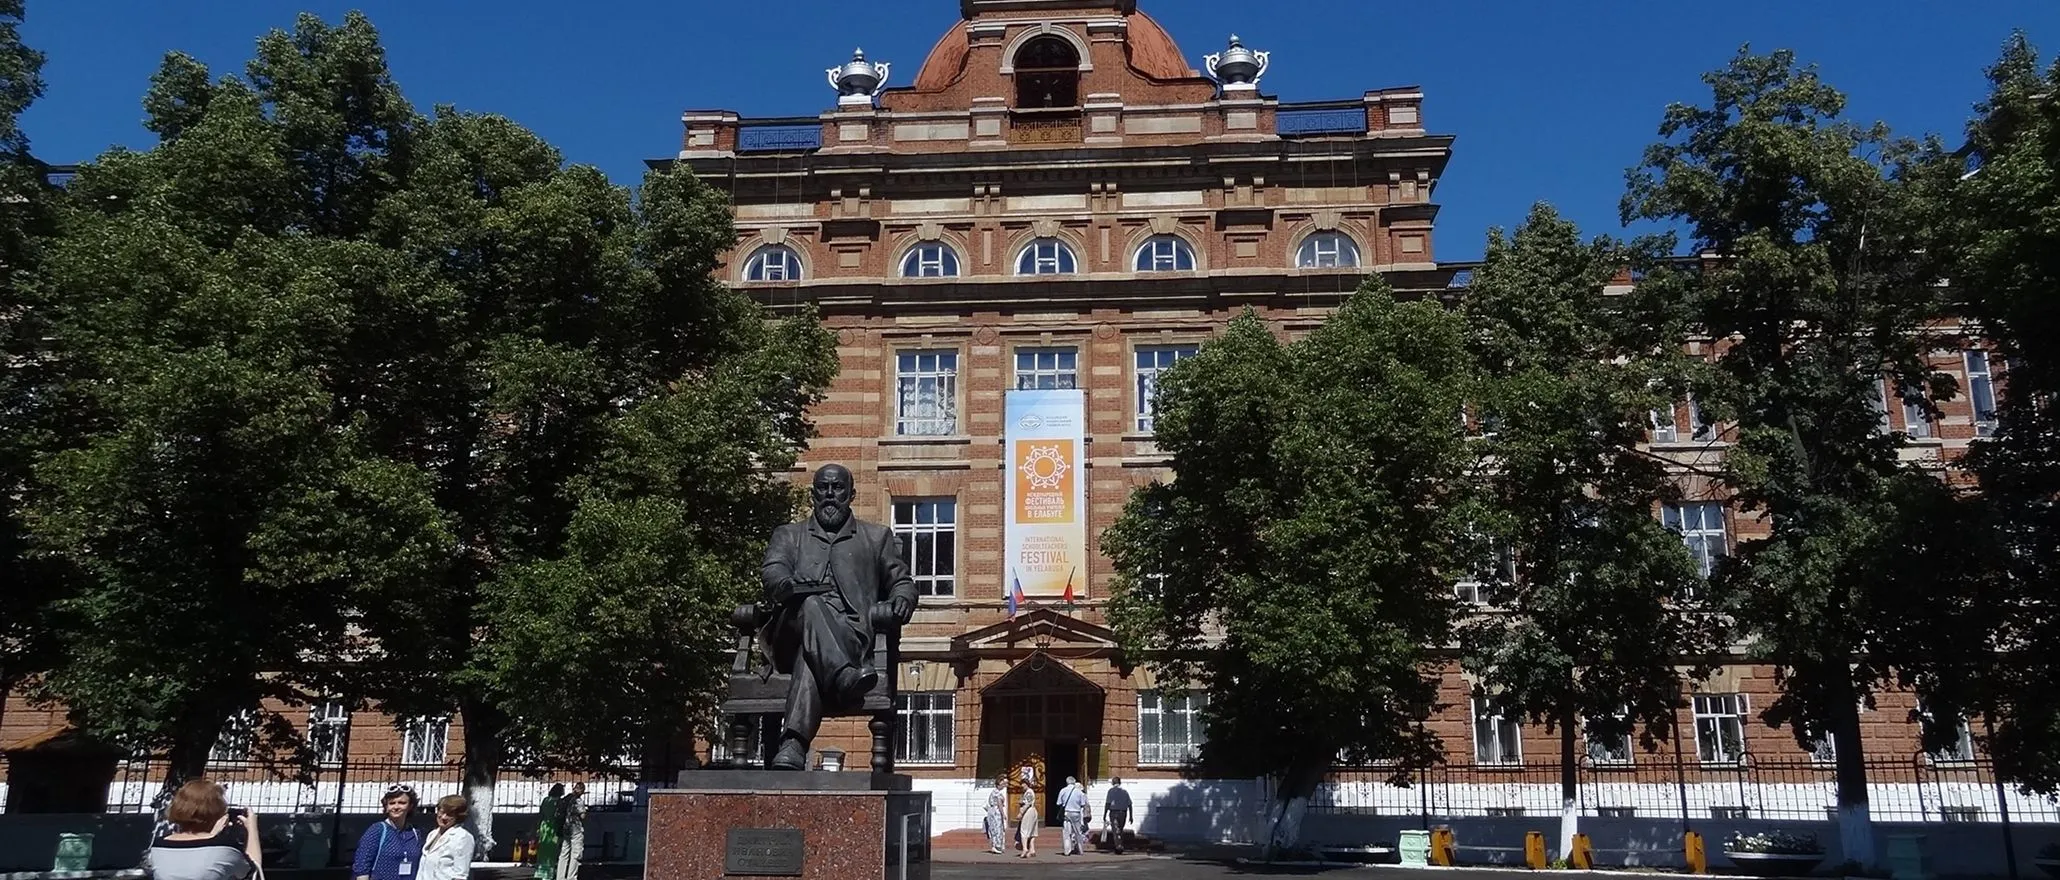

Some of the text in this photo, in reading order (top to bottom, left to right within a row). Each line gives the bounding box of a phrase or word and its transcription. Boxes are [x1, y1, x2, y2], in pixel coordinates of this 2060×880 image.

[1025, 497, 1065, 505] ФЕСТИВАЛЬ
[1027, 510, 1063, 518] В ЕЛАБУГЕ
[1020, 551, 1069, 564] FESTIVAL
